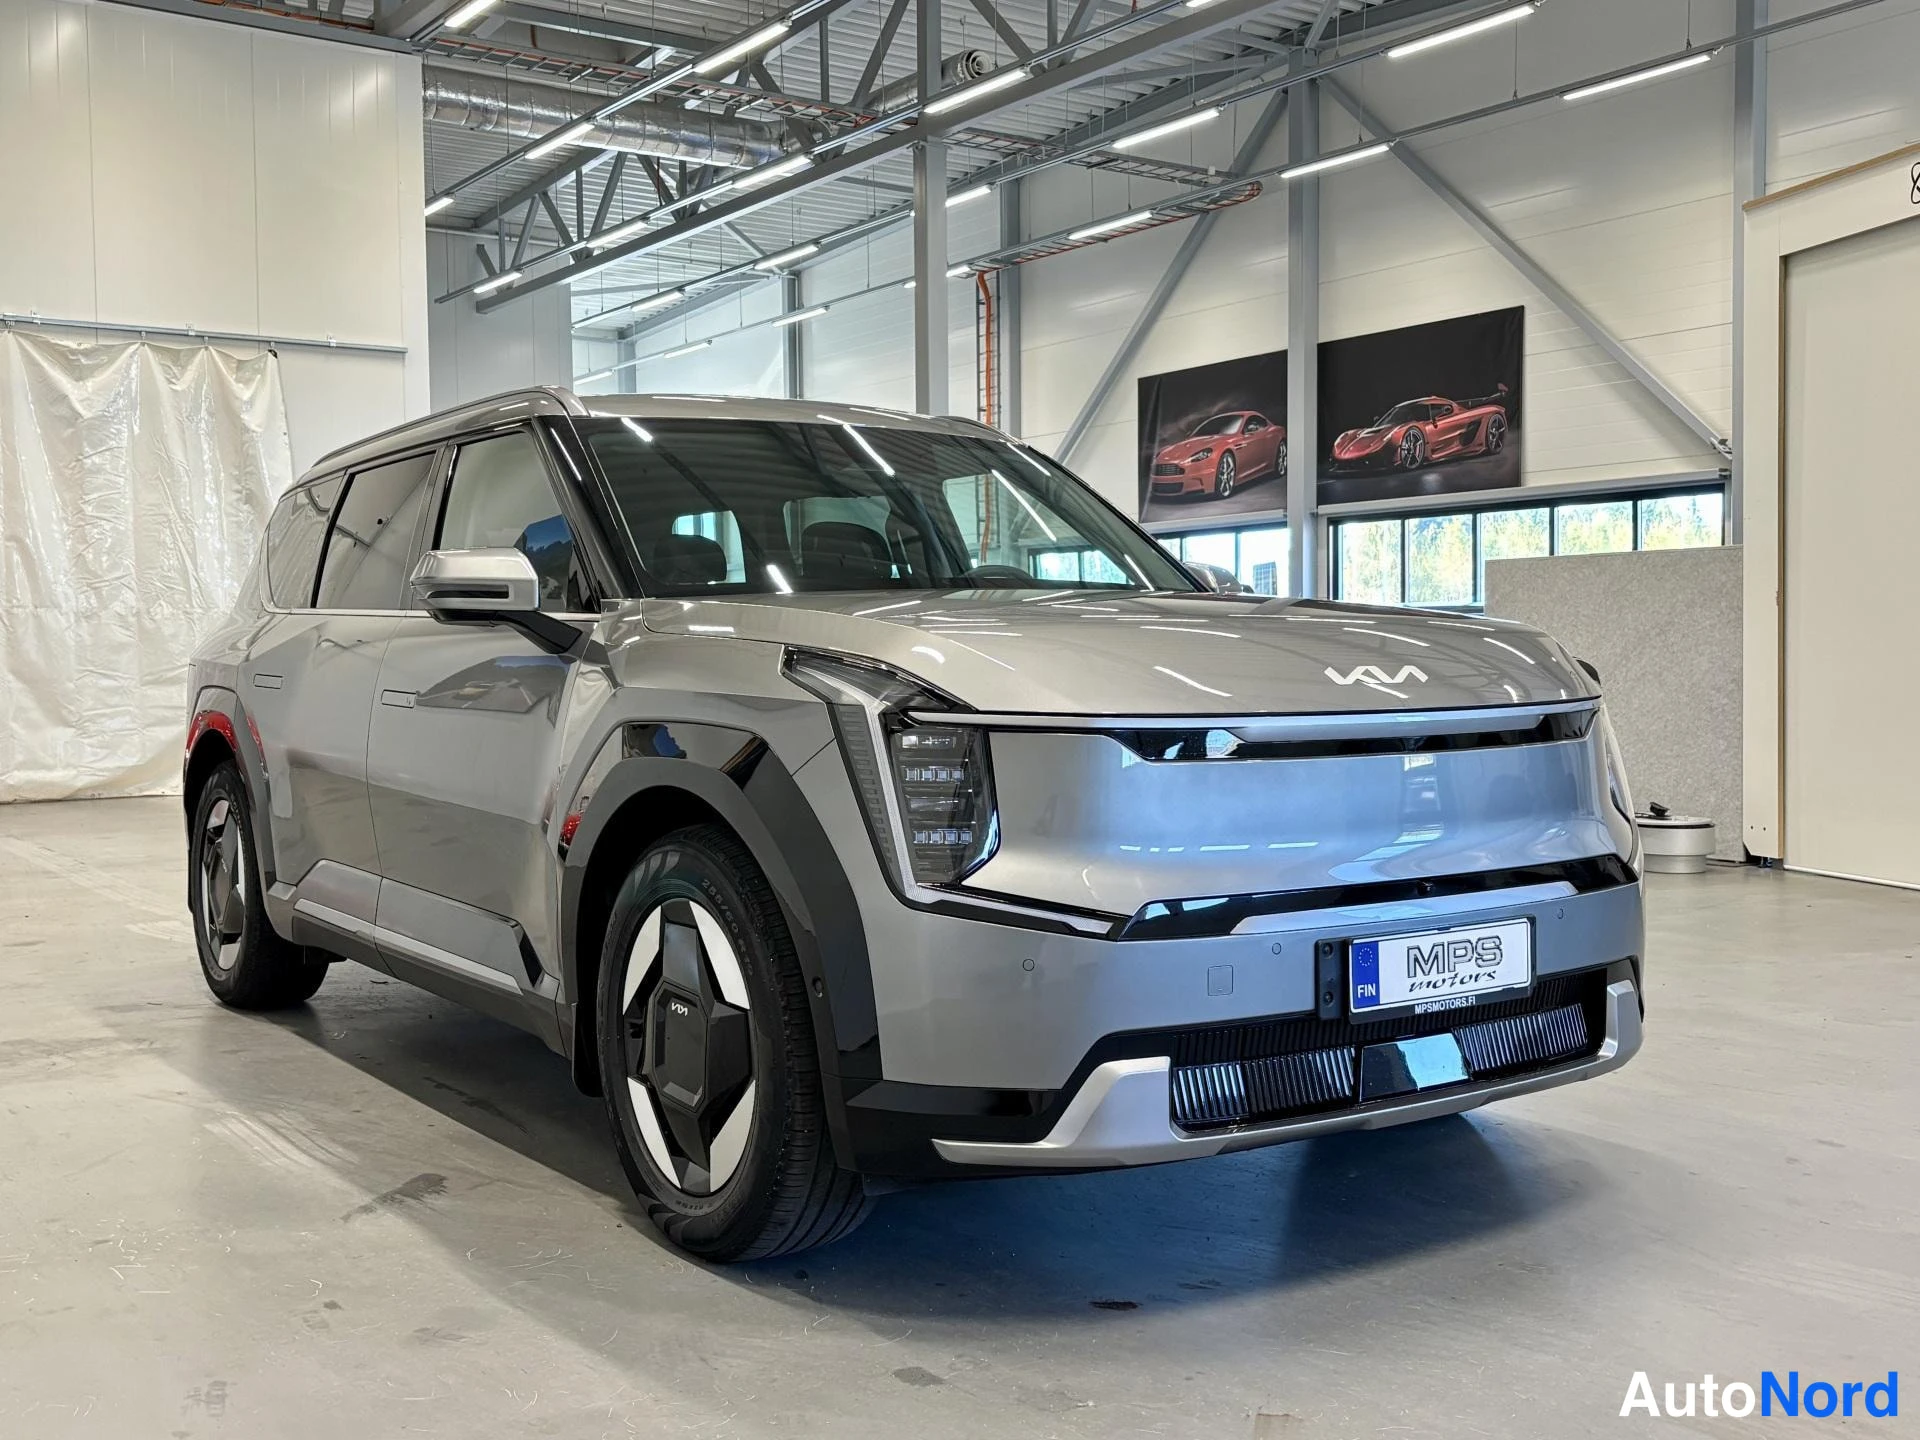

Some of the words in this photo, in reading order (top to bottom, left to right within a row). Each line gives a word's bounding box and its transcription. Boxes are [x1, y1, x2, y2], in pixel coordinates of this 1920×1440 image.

[1406, 935, 1503, 978] MPS
[1357, 983, 1376, 998] FIN
[1408, 970, 1497, 993] motors
[1414, 996, 1476, 1014] MPSMOTORS.FI
